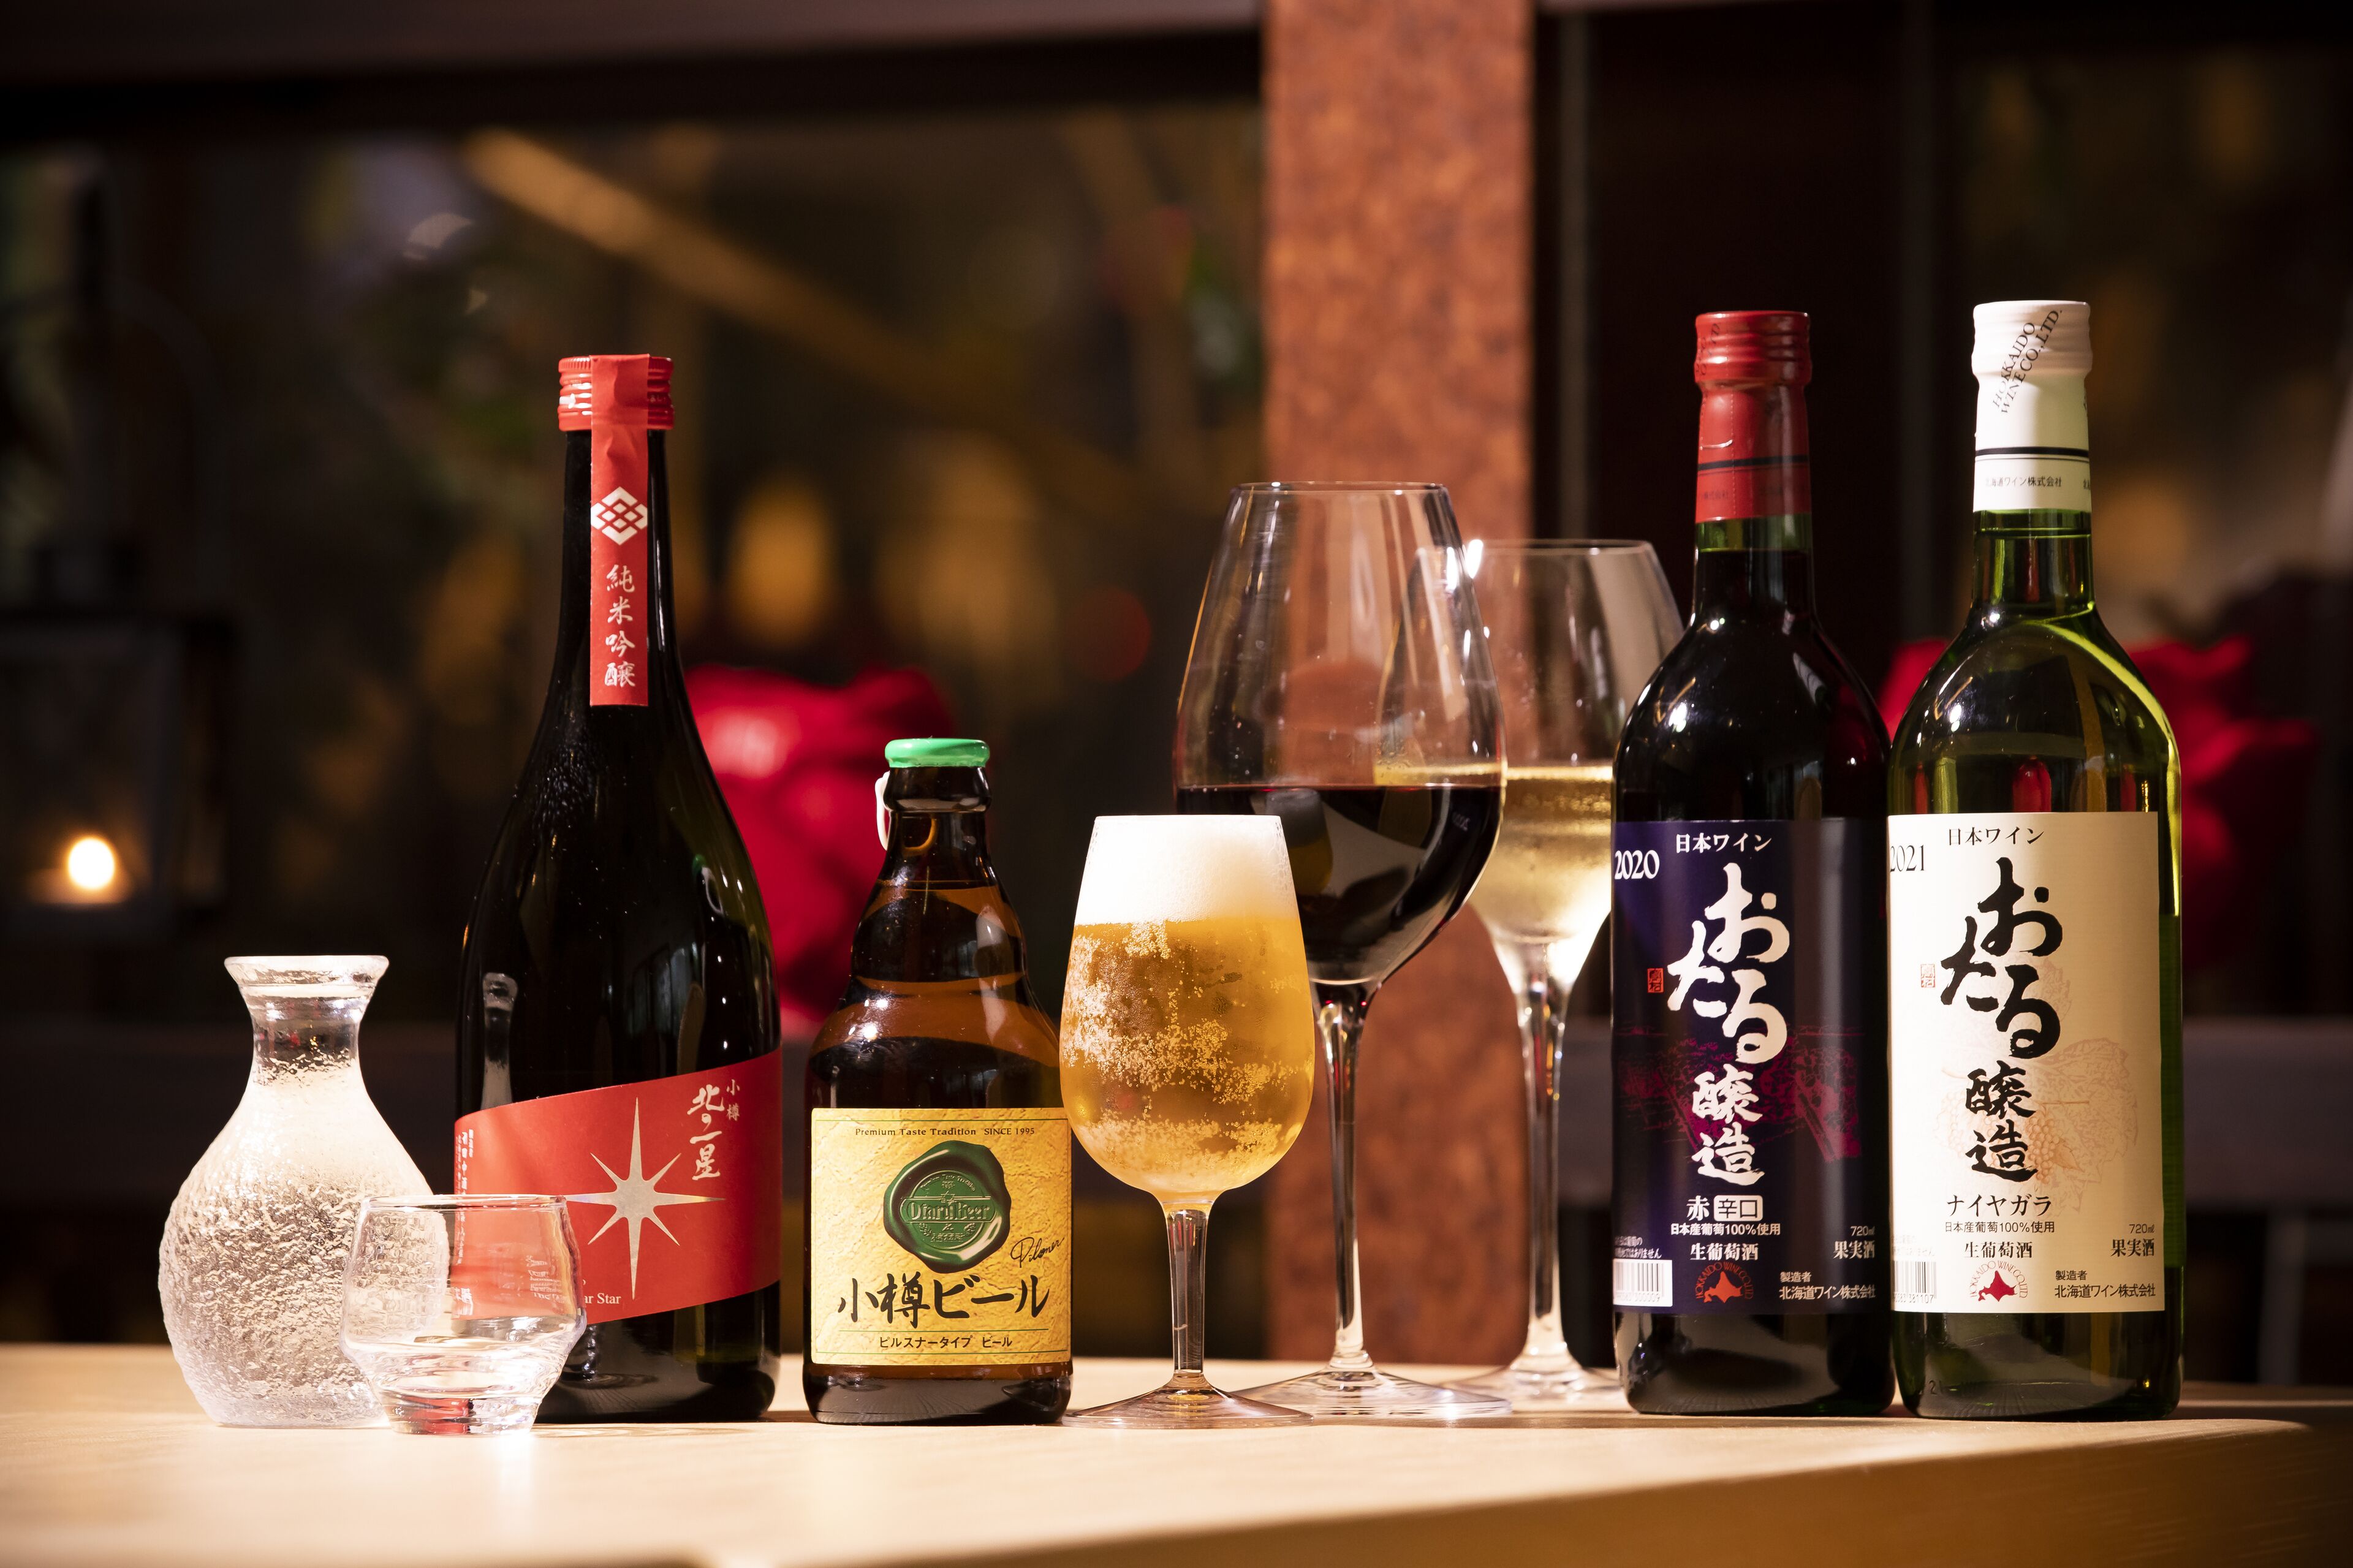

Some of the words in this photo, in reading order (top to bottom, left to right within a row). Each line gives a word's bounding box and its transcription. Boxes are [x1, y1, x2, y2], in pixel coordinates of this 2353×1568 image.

[1993, 322, 2036, 407] HOKKAIDO
[604, 564, 635, 687] 純米吟醸
[1676, 832, 1772, 854] 日本ワイン
[1949, 827, 2044, 846] 日本ワイン
[1614, 849, 1660, 880] 2020
[1890, 845, 1925, 873] 2021
[726, 1079, 740, 1121] 小樽
[687, 1084, 725, 1181] 北の一星
[1686, 1195, 1710, 1221] 赤
[1718, 1198, 1758, 1219] 辛口
[1947, 1194, 2052, 1217] ナイヤガラ
[1670, 1223, 1781, 1237] 日本産葡萄100%使用
[1945, 1221, 2055, 1233] 日本産葡萄100%使用
[1689, 1243, 1759, 1261] 生葡萄酒
[1833, 1240, 1875, 1259] 果実酒
[1965, 1241, 2033, 1259] 生葡萄酒
[2110, 1238, 2155, 1258] 果実酒
[1780, 1272, 1811, 1282] 製造者
[2055, 1270, 2088, 1281] 製造者
[597, 1292, 622, 1305] Star
[838, 1271, 1050, 1328] 小樽ビール
[1779, 1286, 1876, 1300] 北海道ワイン株式会社
[2054, 1284, 2156, 1298] 北海道ワイン株式会社
[879, 1335, 972, 1348] ピルスナータイプ
[982, 1335, 1012, 1348] ビール
